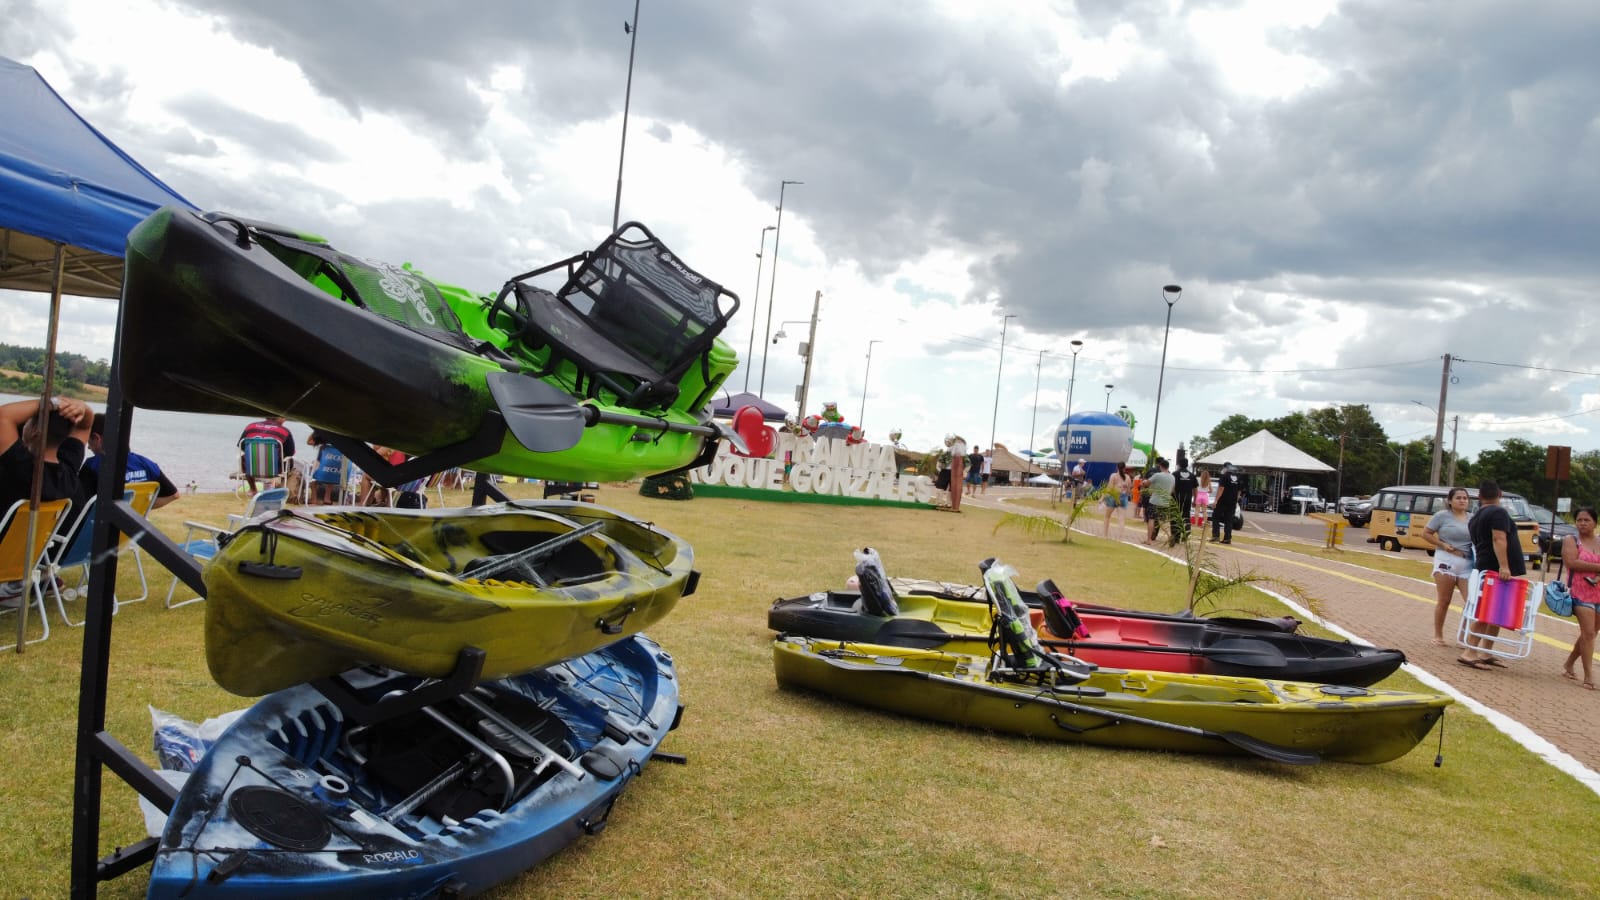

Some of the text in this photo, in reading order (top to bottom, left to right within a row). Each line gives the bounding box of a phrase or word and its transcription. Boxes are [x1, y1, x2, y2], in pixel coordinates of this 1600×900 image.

[1058, 436, 1088, 445] YAHA
[789, 463, 933, 504] GONZALES
[362, 849, 419, 864] ROBALO
